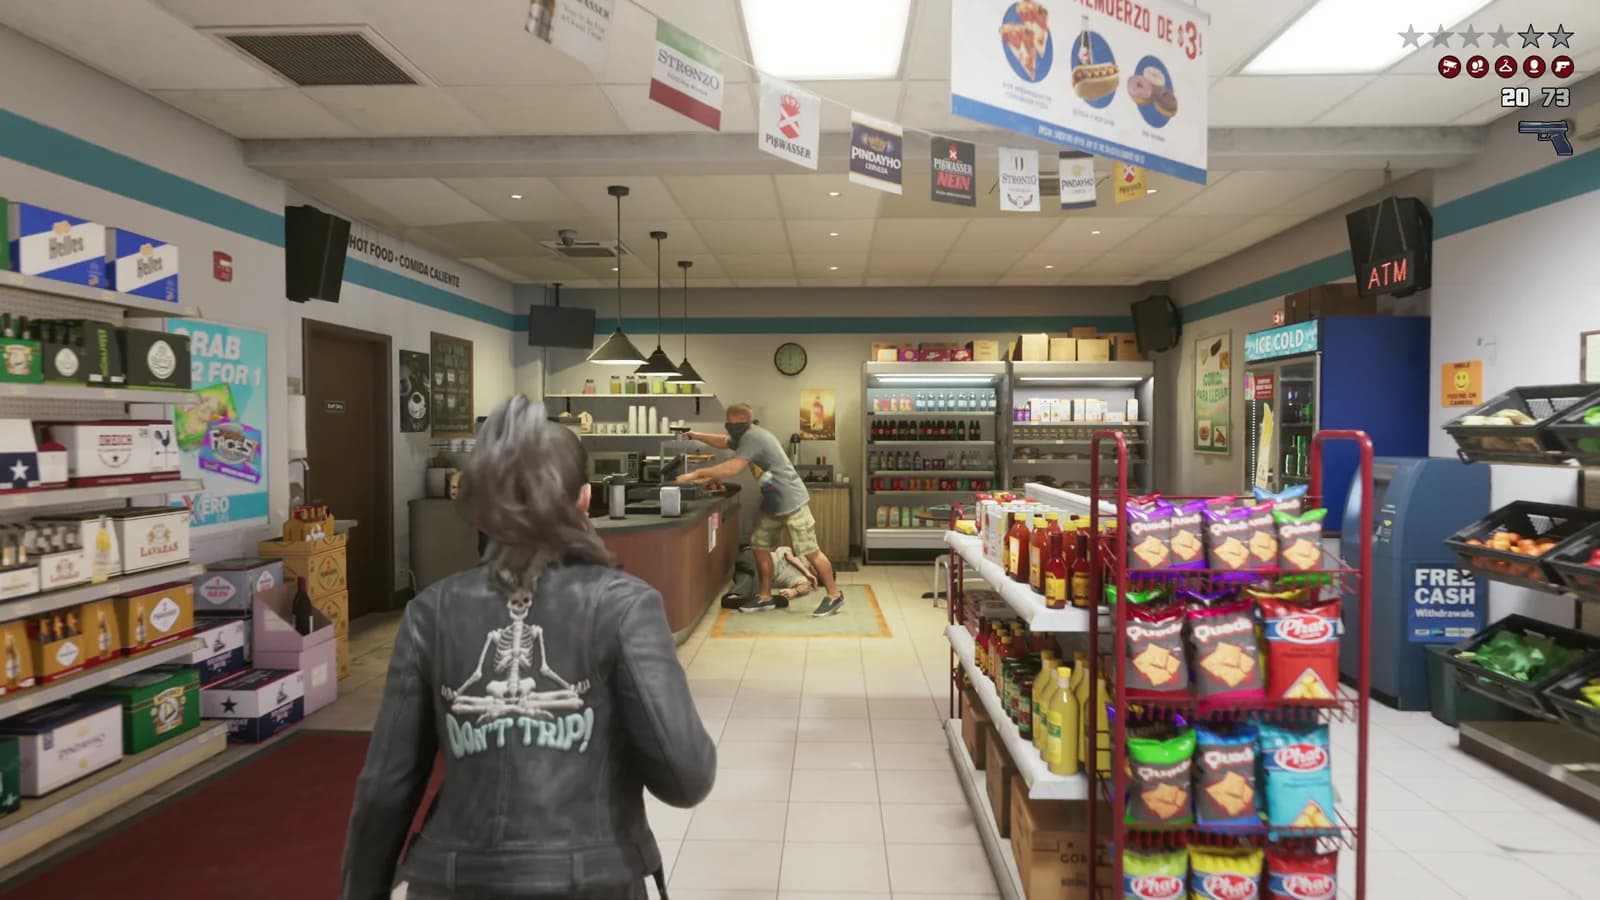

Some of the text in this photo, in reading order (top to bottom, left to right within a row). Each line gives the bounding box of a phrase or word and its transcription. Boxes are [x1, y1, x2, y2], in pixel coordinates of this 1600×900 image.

[1157, 15, 1173, 43] DE
[851, 146, 902, 170] PINDAYHO
[935, 171, 971, 192] NEIN
[348, 234, 461, 289] HOT FOOD COMIDA CALIENTE
[1367, 257, 1408, 290] ATM
[1255, 328, 1305, 355] ICE COLD
[190, 361, 263, 387] 2 FOR 1
[1414, 588, 1476, 605] CASH
[1415, 608, 1475, 618] Withdrawals
[517, 707, 594, 753] TRIP!
